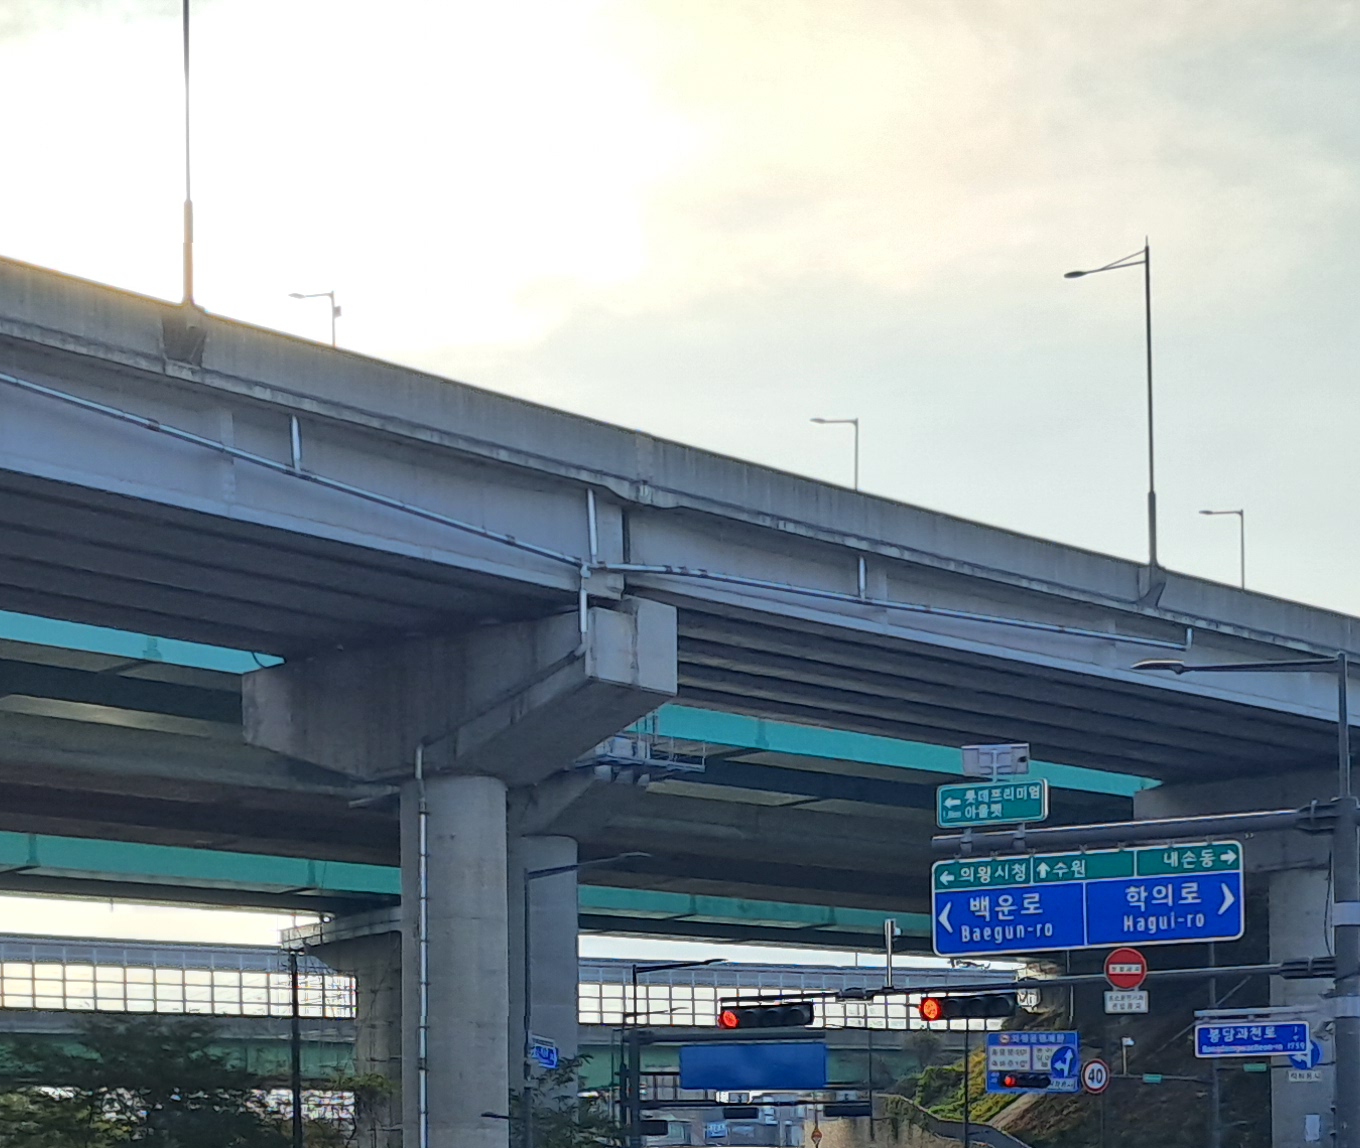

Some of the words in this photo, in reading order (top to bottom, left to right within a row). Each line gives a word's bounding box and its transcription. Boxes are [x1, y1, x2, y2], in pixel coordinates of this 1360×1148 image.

[964, 785, 1040, 804] 롯데프리미엄
[964, 803, 1002, 819] 아울렛
[1051, 859, 1086, 879] 수원
[1163, 849, 1216, 869] 내손동
[958, 863, 1027, 884] 의왕시청
[1124, 882, 1202, 912] 학의로
[969, 893, 1044, 922] 백운로
[1123, 912, 1205, 934] Hagui-ro
[960, 923, 1053, 944] Baegun-ro
[1207, 1026, 1277, 1042] 봉담과천로
[1088, 1068, 1103, 1084] 40
